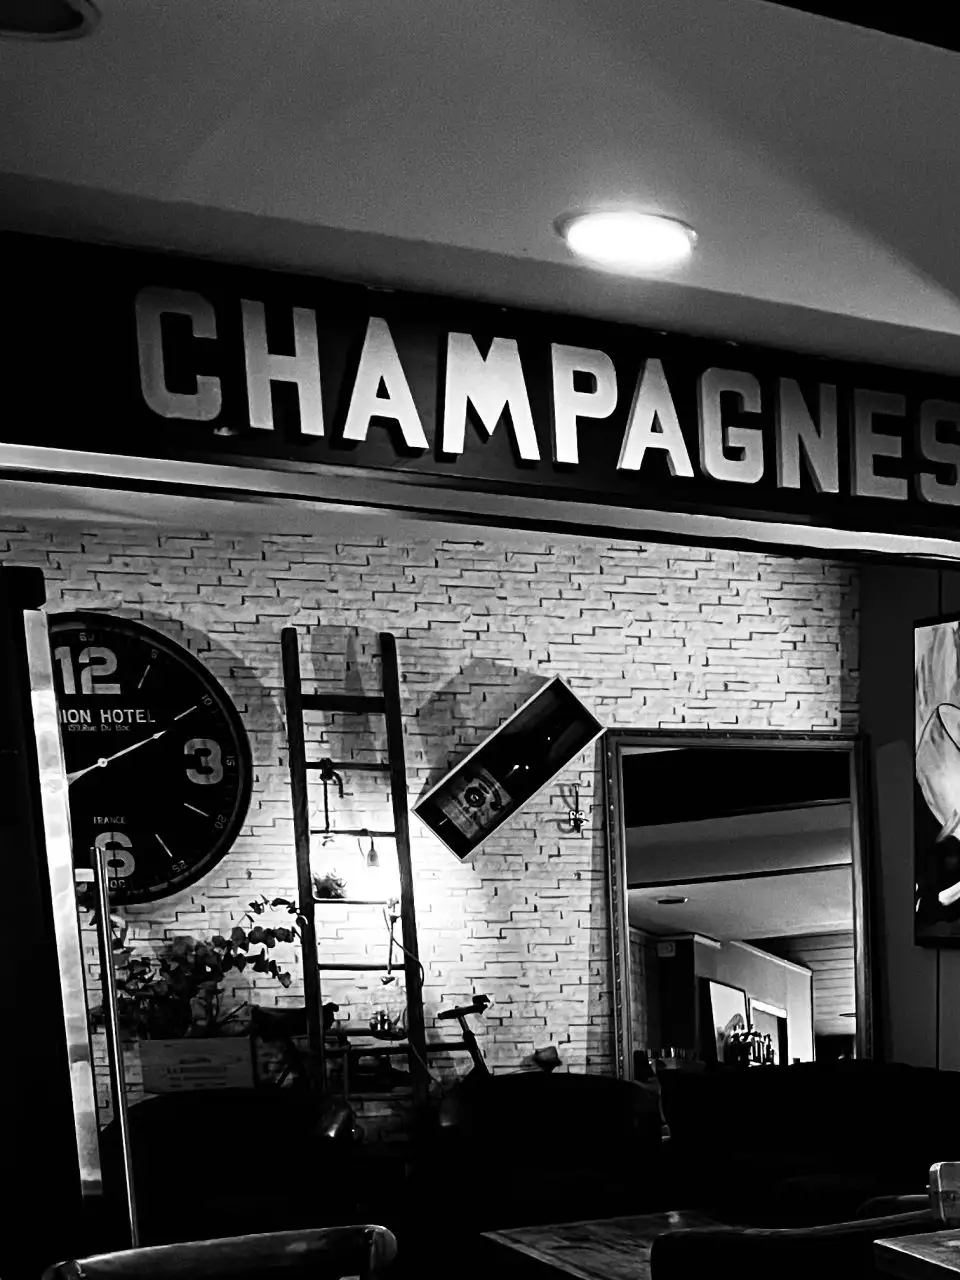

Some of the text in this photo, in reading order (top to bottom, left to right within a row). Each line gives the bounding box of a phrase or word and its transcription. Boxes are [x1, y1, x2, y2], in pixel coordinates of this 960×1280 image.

[54, 646, 121, 695] 12
[60, 709, 155, 723] ION HOTEL
[201, 693, 213, 707] 10
[184, 738, 224, 784] 3
[95, 832, 135, 878] 6
